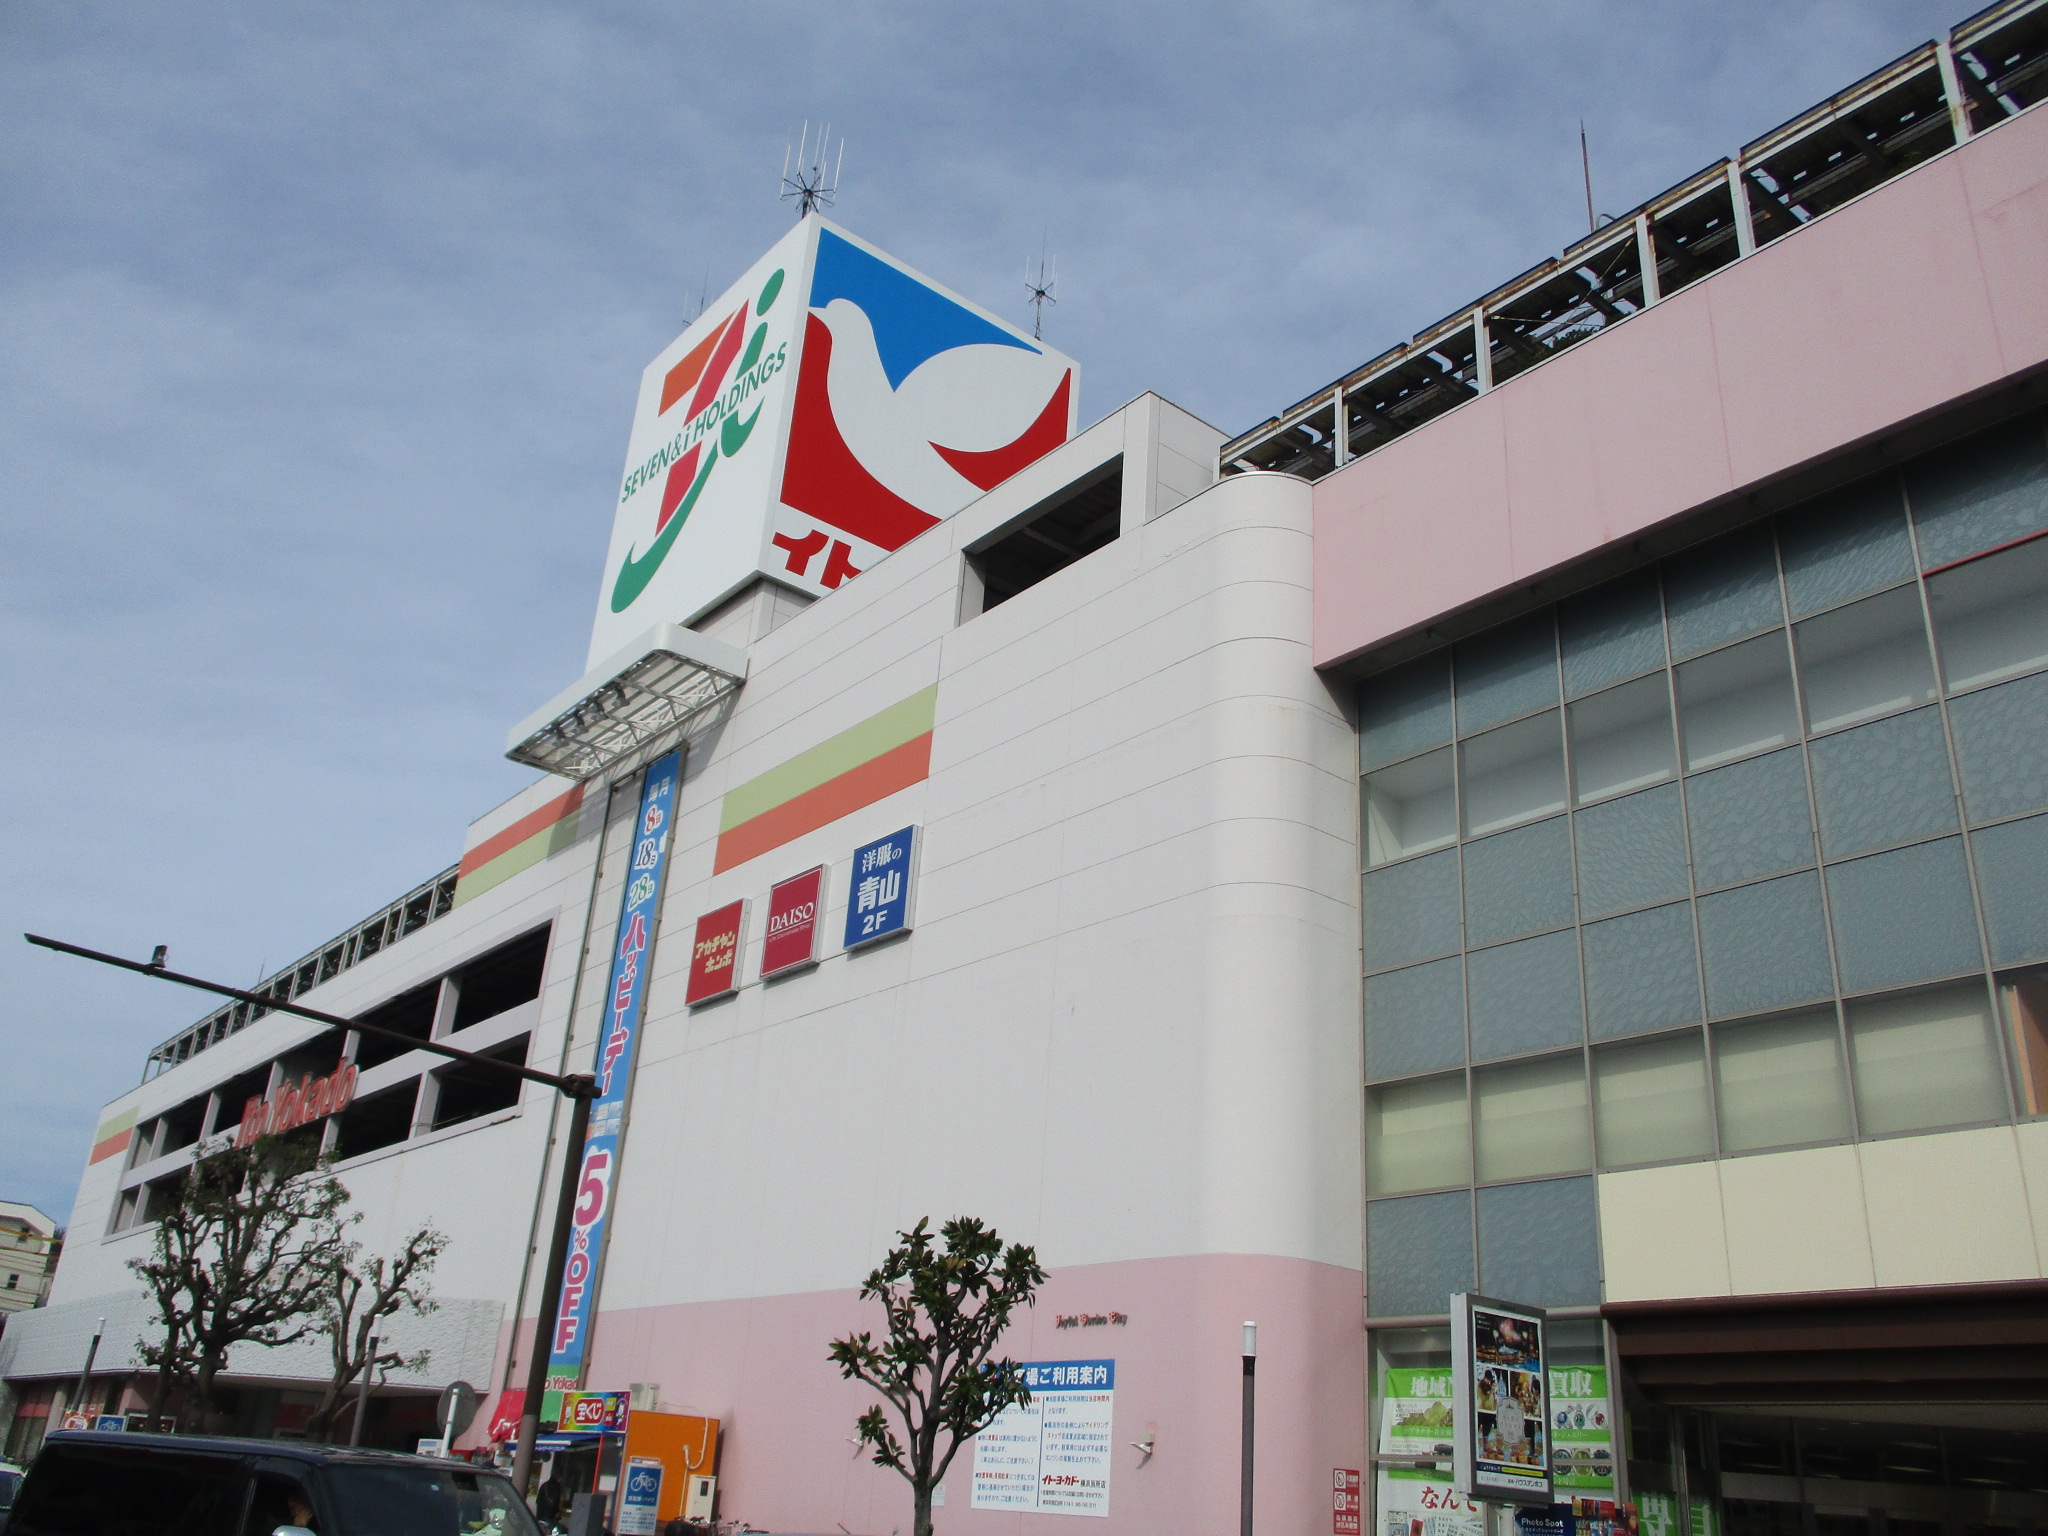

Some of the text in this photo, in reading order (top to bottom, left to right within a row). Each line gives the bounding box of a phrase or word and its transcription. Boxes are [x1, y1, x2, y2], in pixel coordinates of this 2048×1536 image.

[692, 341, 788, 444] HOLDINGS
[771, 528, 863, 591] イト
[862, 842, 902, 875] 洋服の
[857, 869, 901, 915] 青山
[770, 901, 814, 933] DAISO
[861, 909, 888, 935] 2F
[695, 930, 736, 960] アカチャン
[601, 911, 646, 1096] ハッピーデー
[265, 1056, 360, 1135] Yokado
[1549, 1370, 1592, 1397] 買取
[576, 1402, 602, 1421] 宝くじ
[1521, 1518, 1564, 1529] Photo Spot
